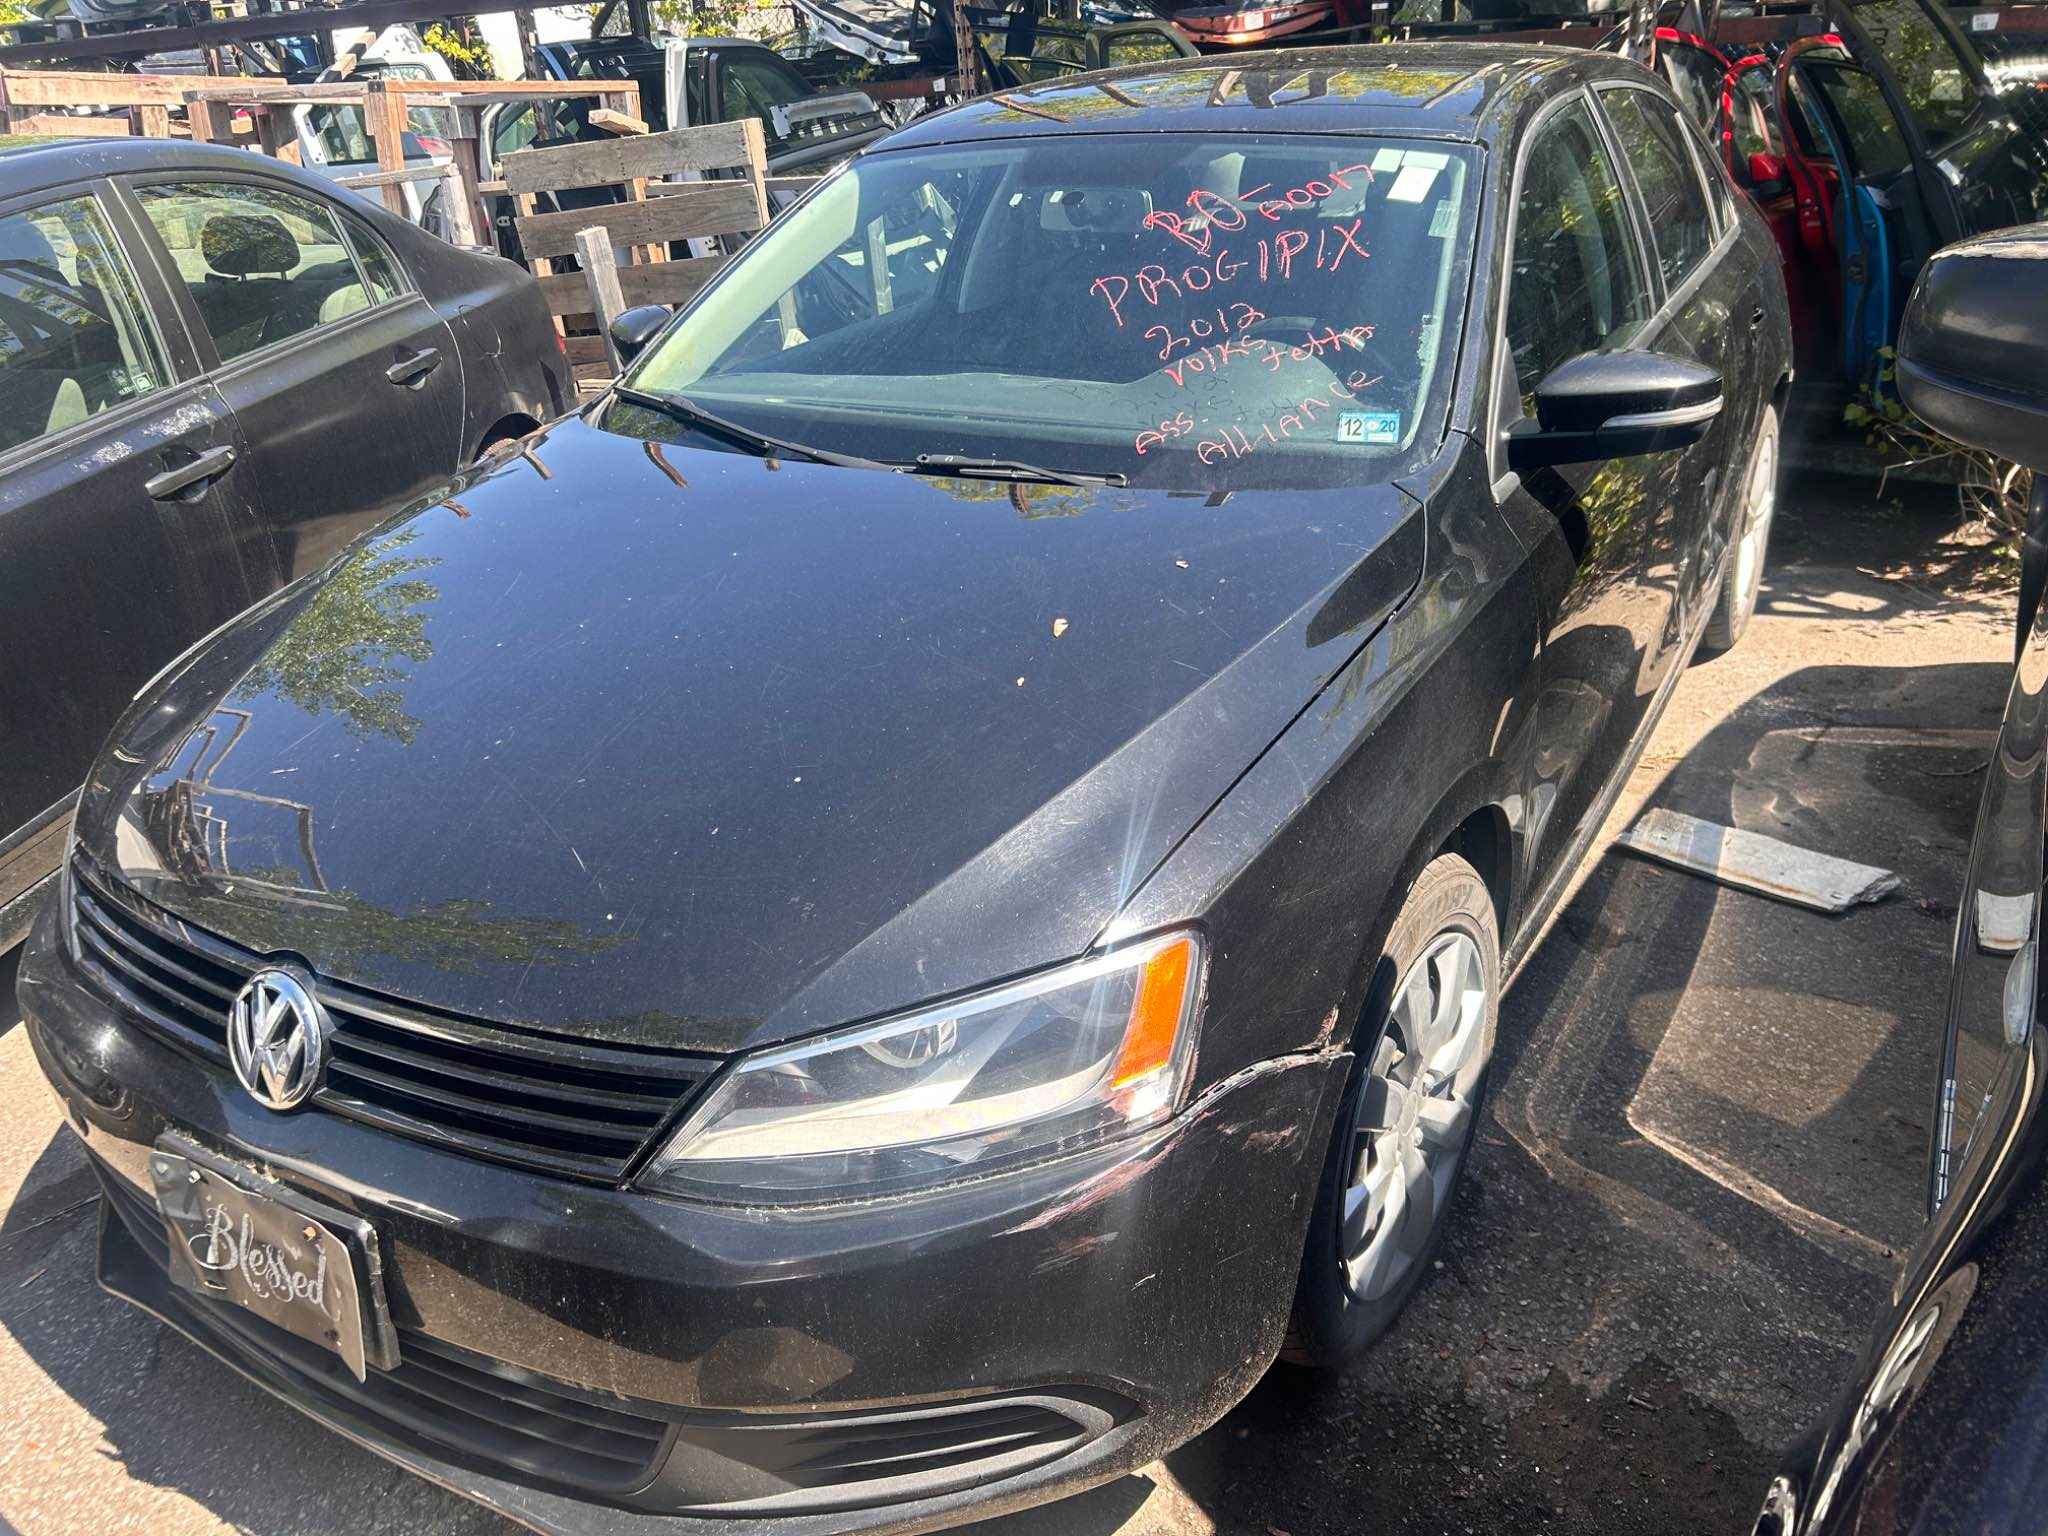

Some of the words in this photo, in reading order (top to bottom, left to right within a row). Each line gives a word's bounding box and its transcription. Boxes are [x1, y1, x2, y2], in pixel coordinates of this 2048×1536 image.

[1144, 302, 1266, 361] 2012
[1344, 418, 1363, 436] 12
[1380, 419, 1396, 433] 20
[187, 1203, 341, 1322] Blessed
